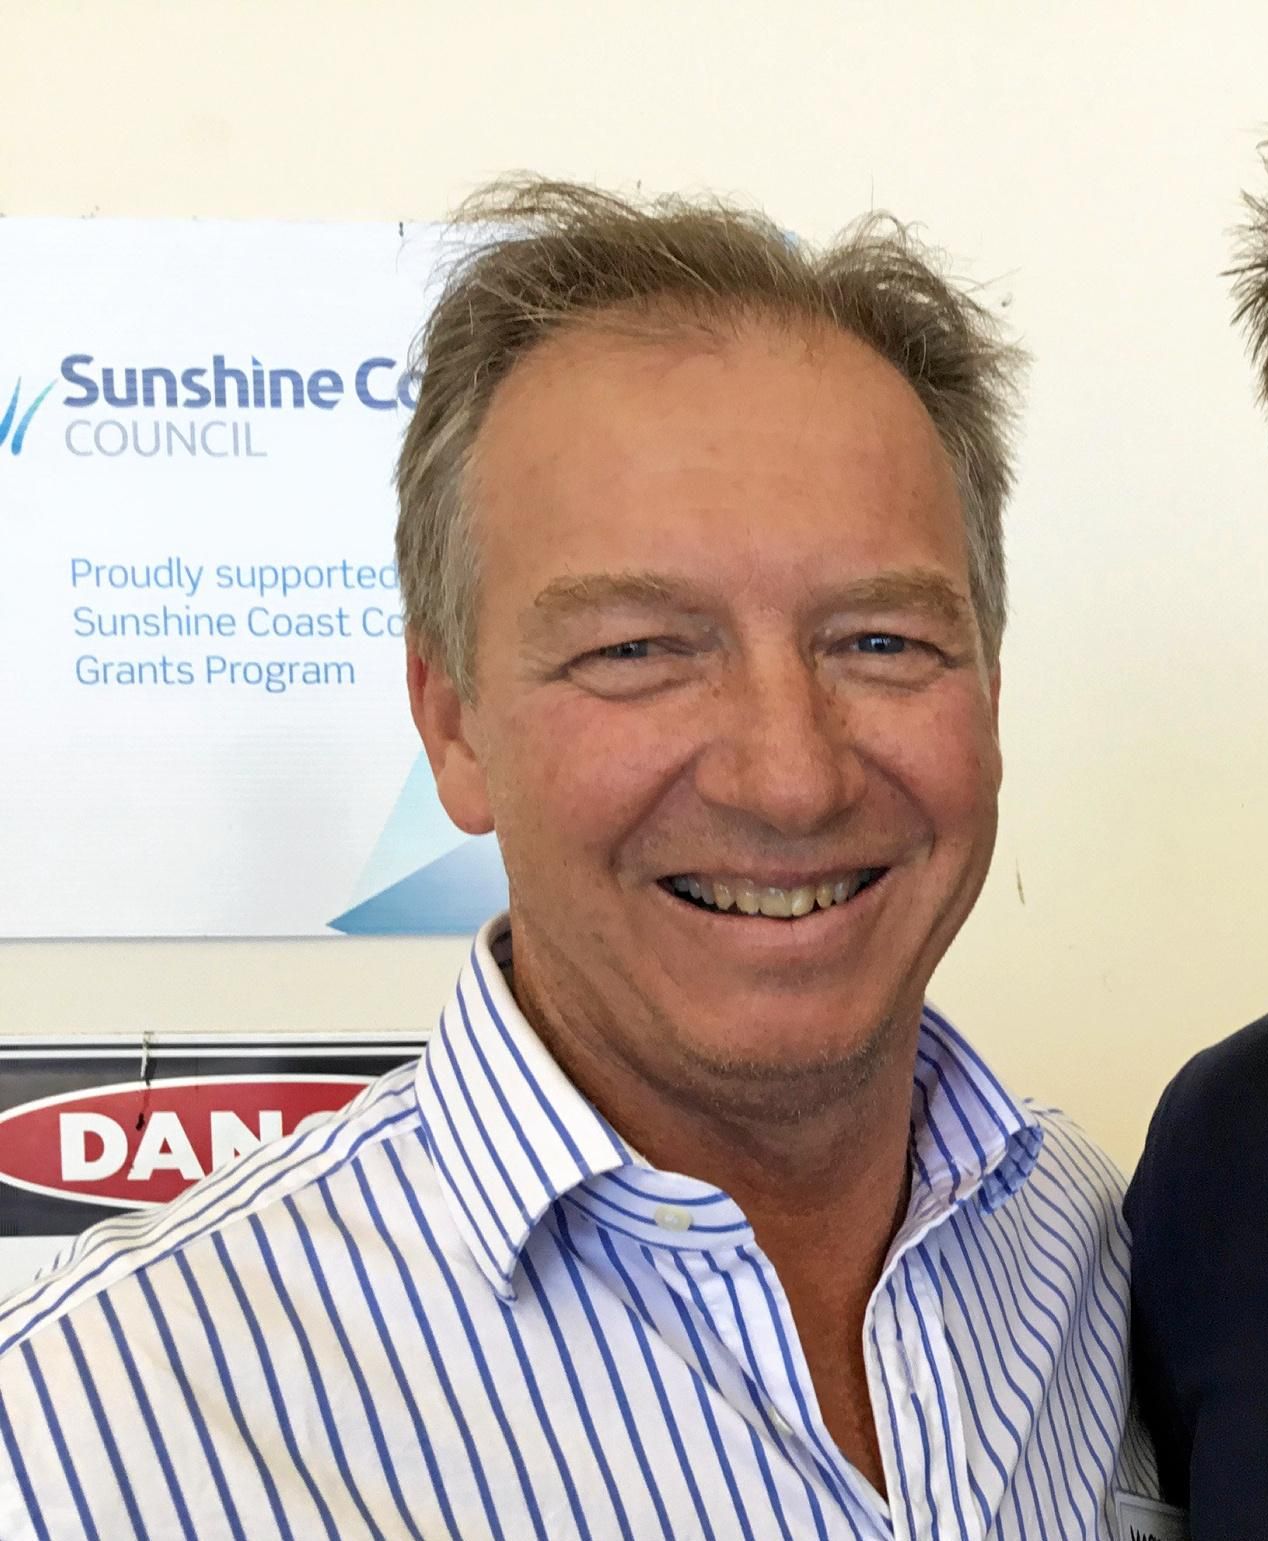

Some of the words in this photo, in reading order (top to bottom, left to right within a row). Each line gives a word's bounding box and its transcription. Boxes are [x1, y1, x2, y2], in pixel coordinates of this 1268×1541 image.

[60, 353, 345, 411] Sunshine
[65, 419, 268, 458] COUNCIL
[71, 556, 204, 598] Proudly
[215, 558, 400, 598] supported
[73, 604, 237, 638] Sunshine
[247, 606, 352, 638] Coast
[75, 654, 195, 686] Grants
[205, 655, 357, 694] Program
[59, 1110, 338, 1182] DAN
